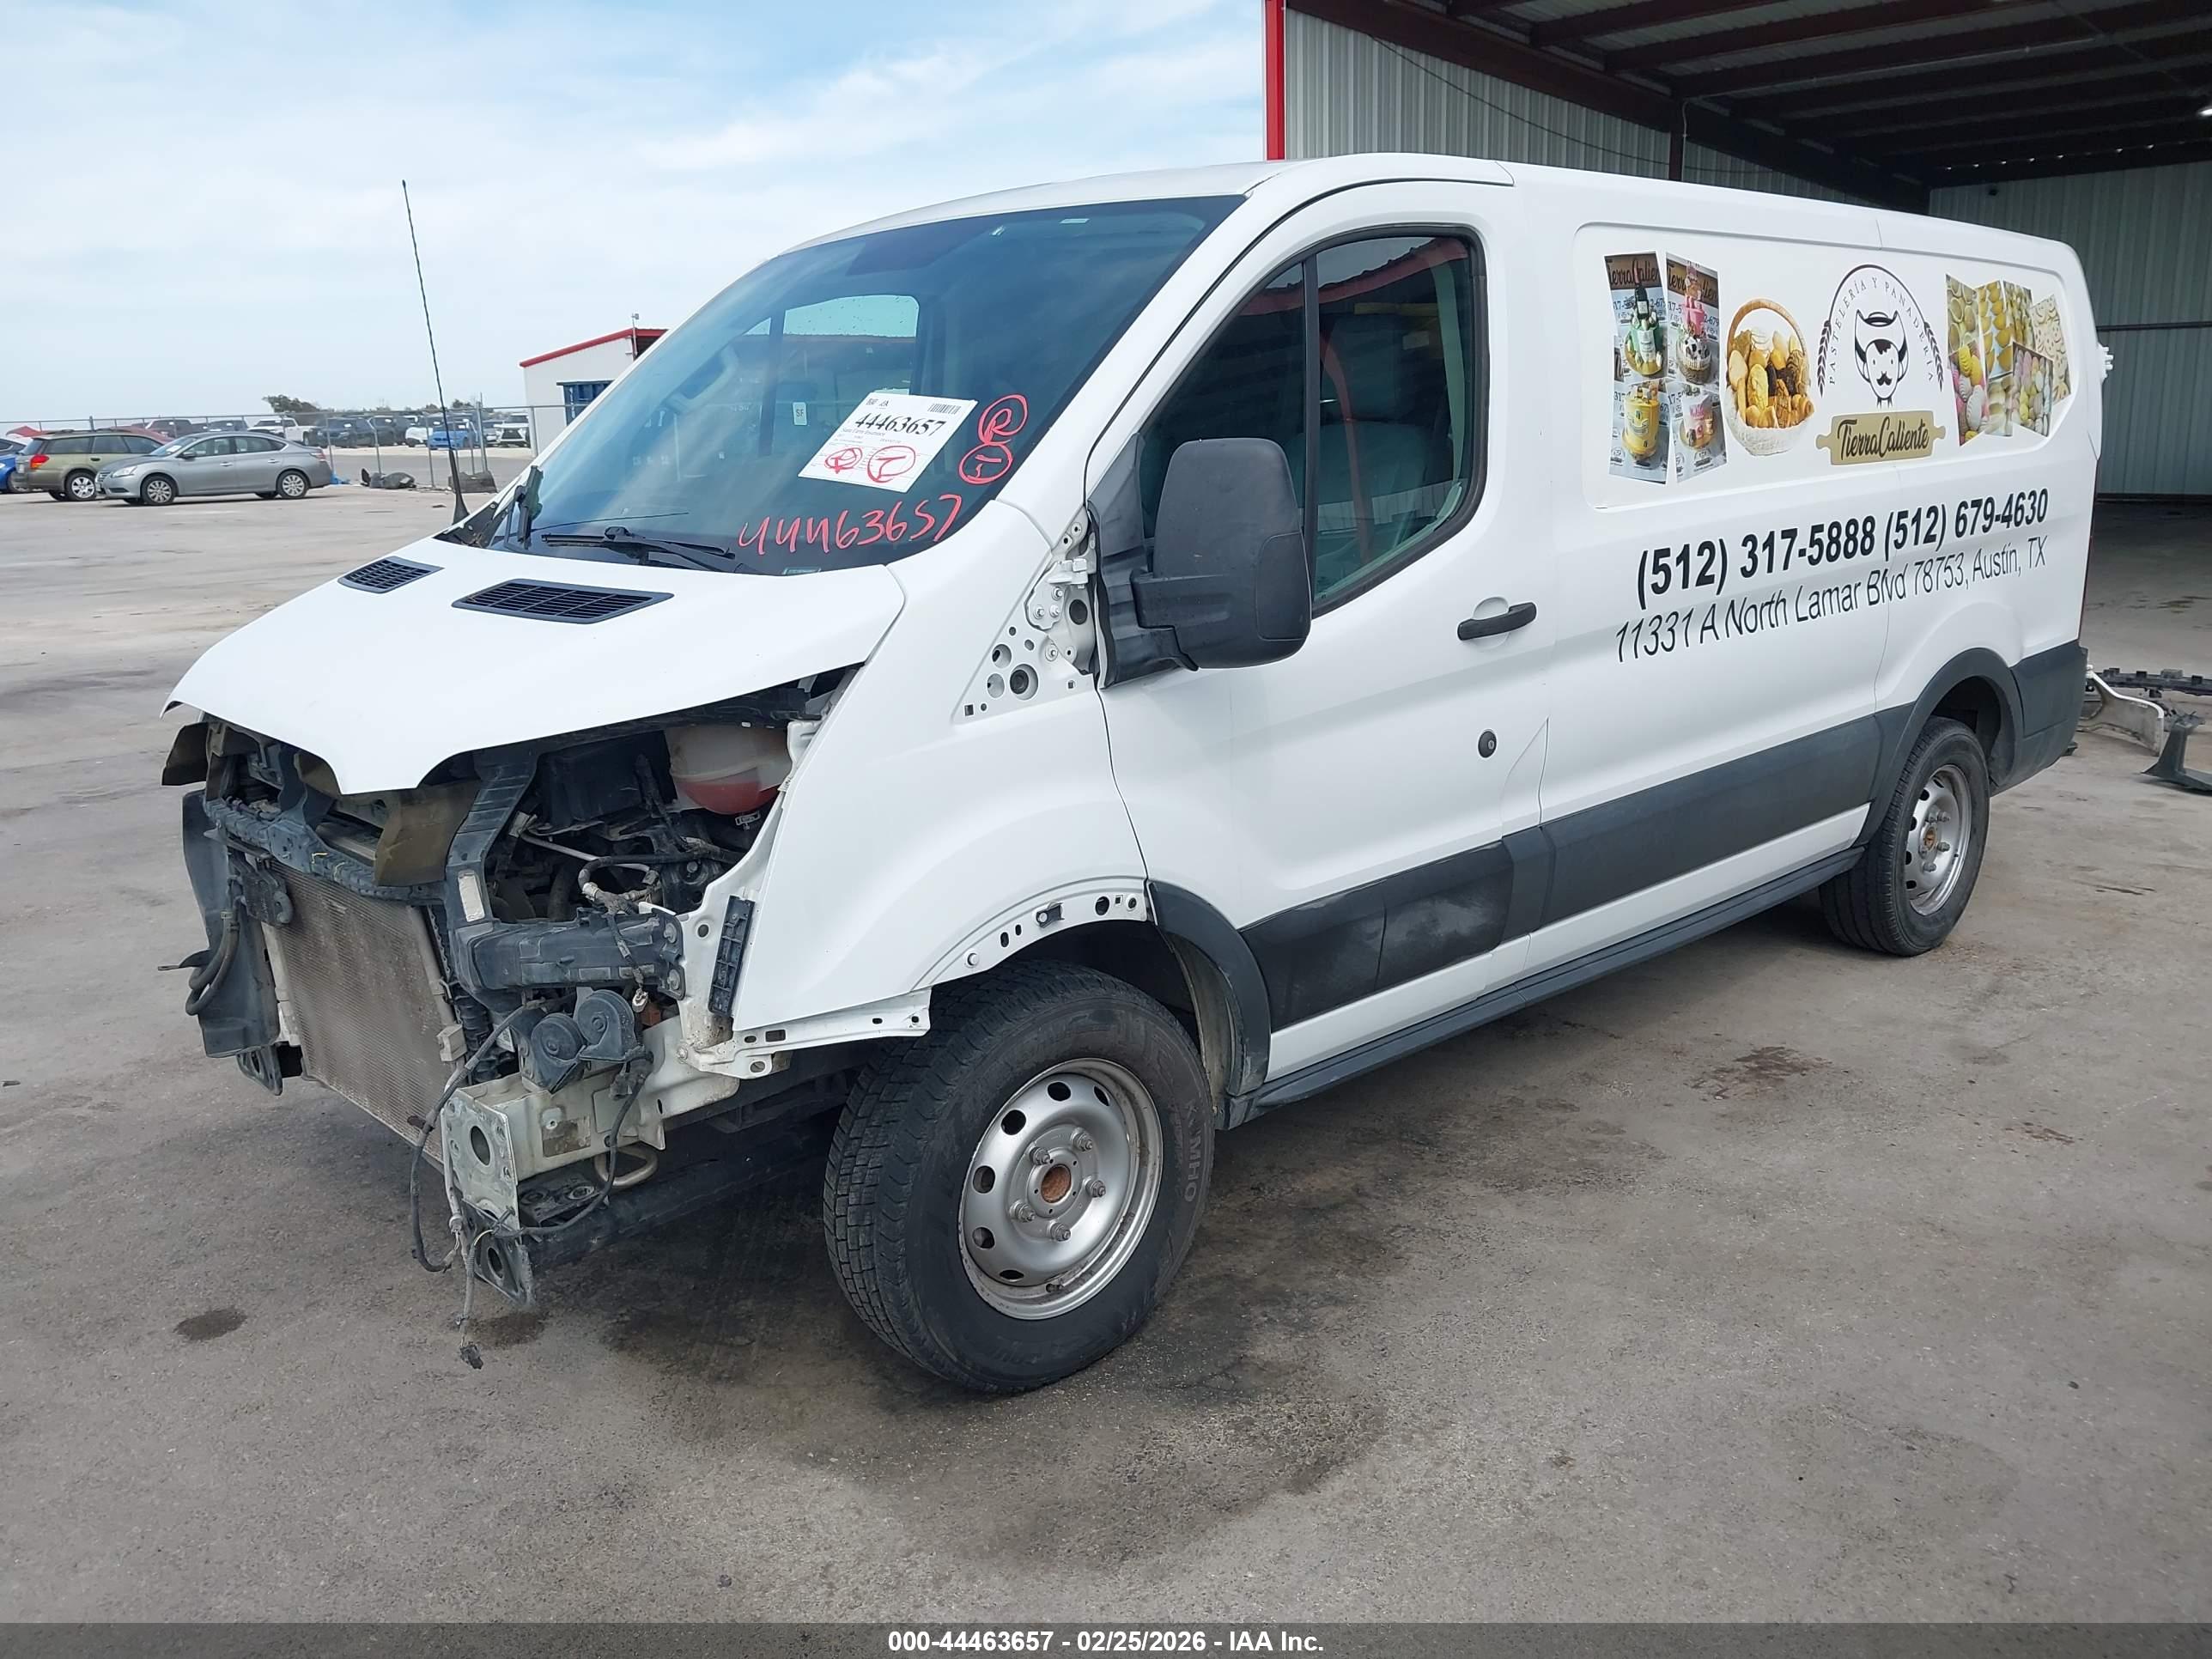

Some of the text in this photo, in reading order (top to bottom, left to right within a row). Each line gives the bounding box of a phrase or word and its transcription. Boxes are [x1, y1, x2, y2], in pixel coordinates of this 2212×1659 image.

[1871, 276, 1878, 289] Y
[854, 412, 948, 437] 44463657
[1837, 416, 1930, 461] TierraCaliente
[737, 494, 963, 556] 44463657
[1638, 488, 2049, 611] (512) 317-5888 (512) 679-4630
[1615, 607, 1694, 663] 11331
[1698, 603, 1720, 645] A
[1724, 589, 1789, 639] North
[1795, 580, 1862, 623] Lamar
[1867, 562, 1909, 606] Blvd
[1913, 552, 1969, 595] 78753,
[2027, 535, 2048, 568] TX
